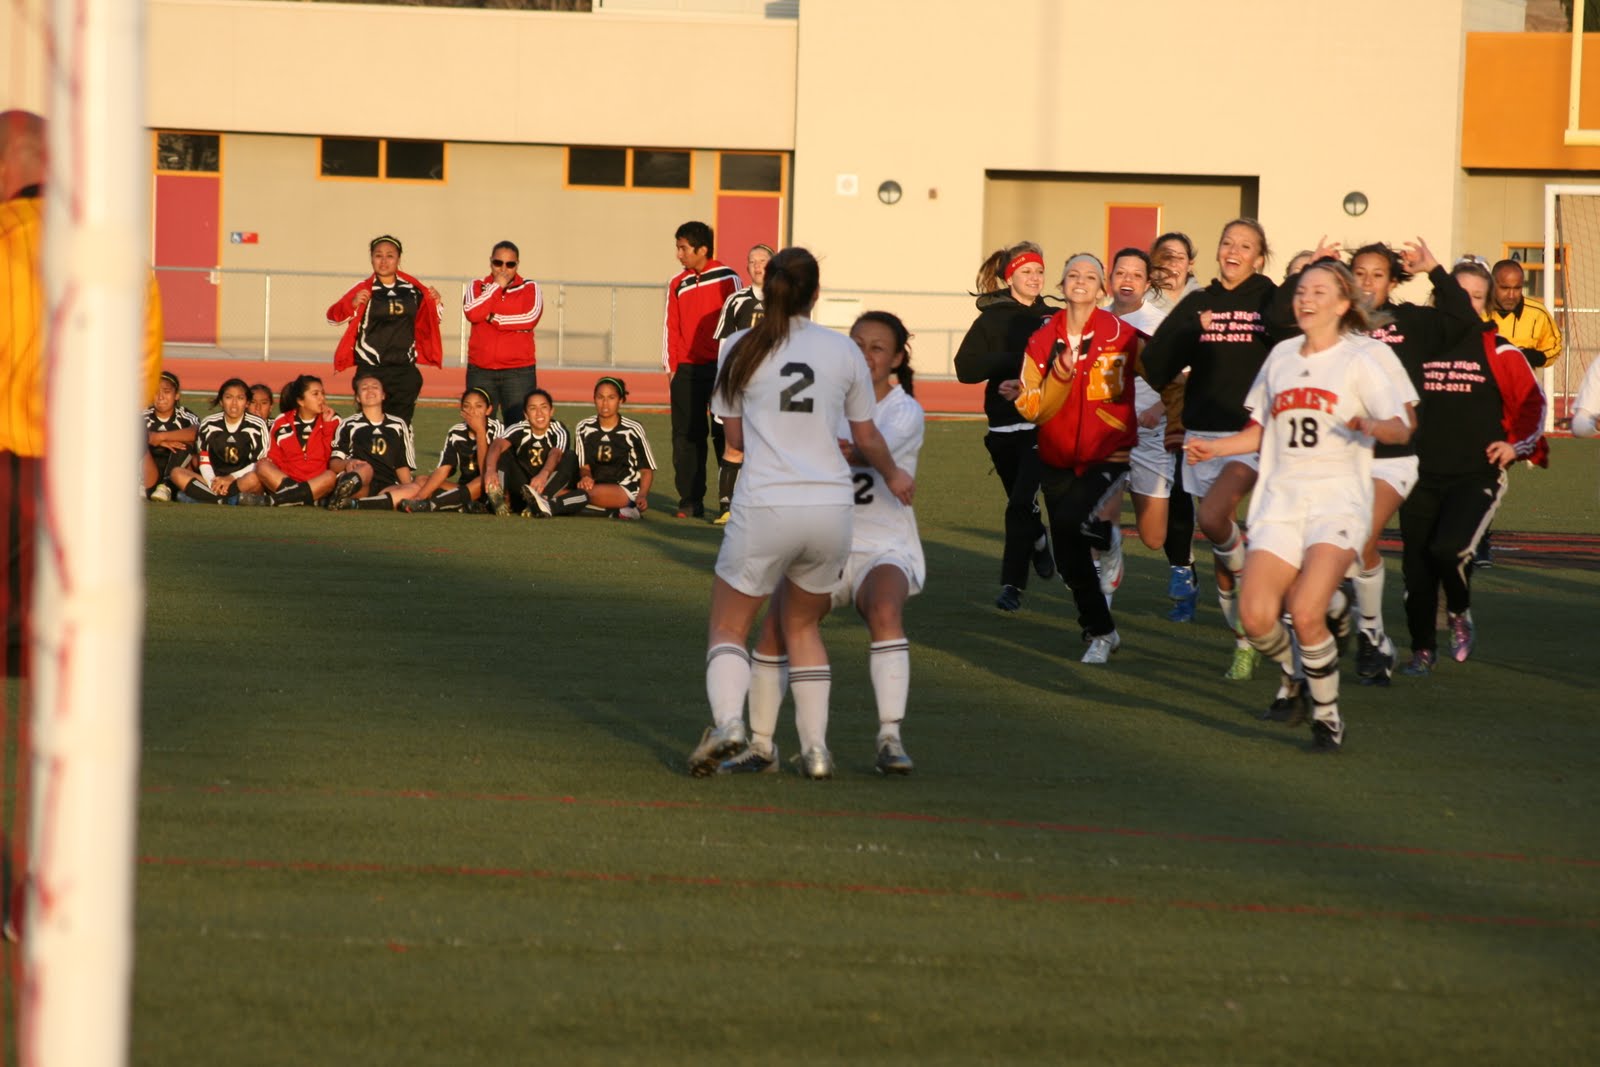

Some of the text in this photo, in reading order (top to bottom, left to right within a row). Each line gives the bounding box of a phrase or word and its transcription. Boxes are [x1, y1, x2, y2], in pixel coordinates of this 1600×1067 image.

[389, 299, 404, 315] 15
[780, 362, 815, 413] 2
[1423, 382, 1472, 393] 010-2011
[1288, 417, 1319, 448] 18
[225, 446, 239, 464] 18
[371, 437, 387, 455] 10
[598, 445, 612, 462] 13
